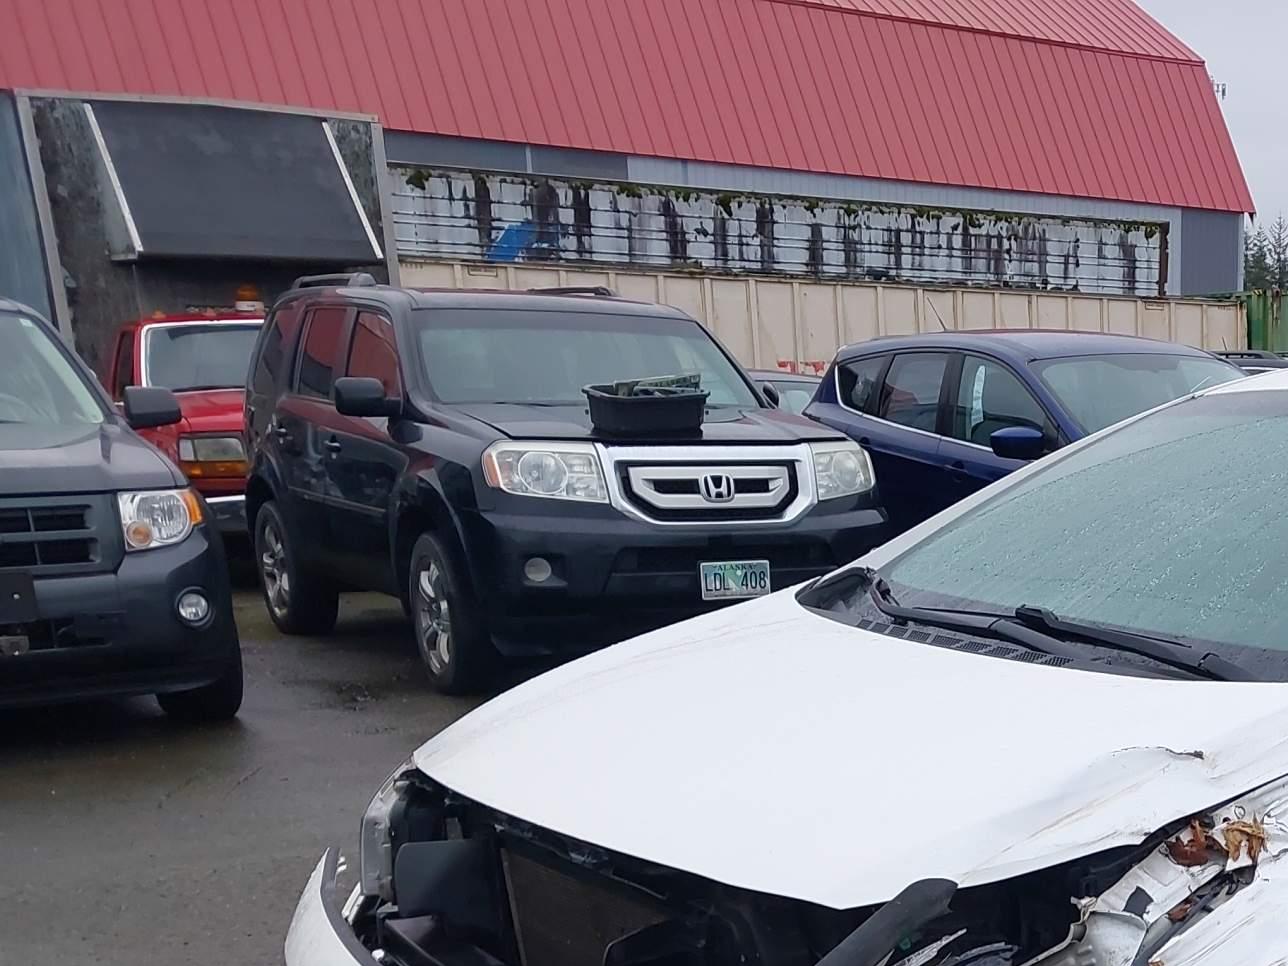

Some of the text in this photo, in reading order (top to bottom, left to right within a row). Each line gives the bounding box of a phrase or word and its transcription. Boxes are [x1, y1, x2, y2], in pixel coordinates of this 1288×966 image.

[717, 563, 755, 571] ALASKA
[704, 570, 767, 592] LDL 408
